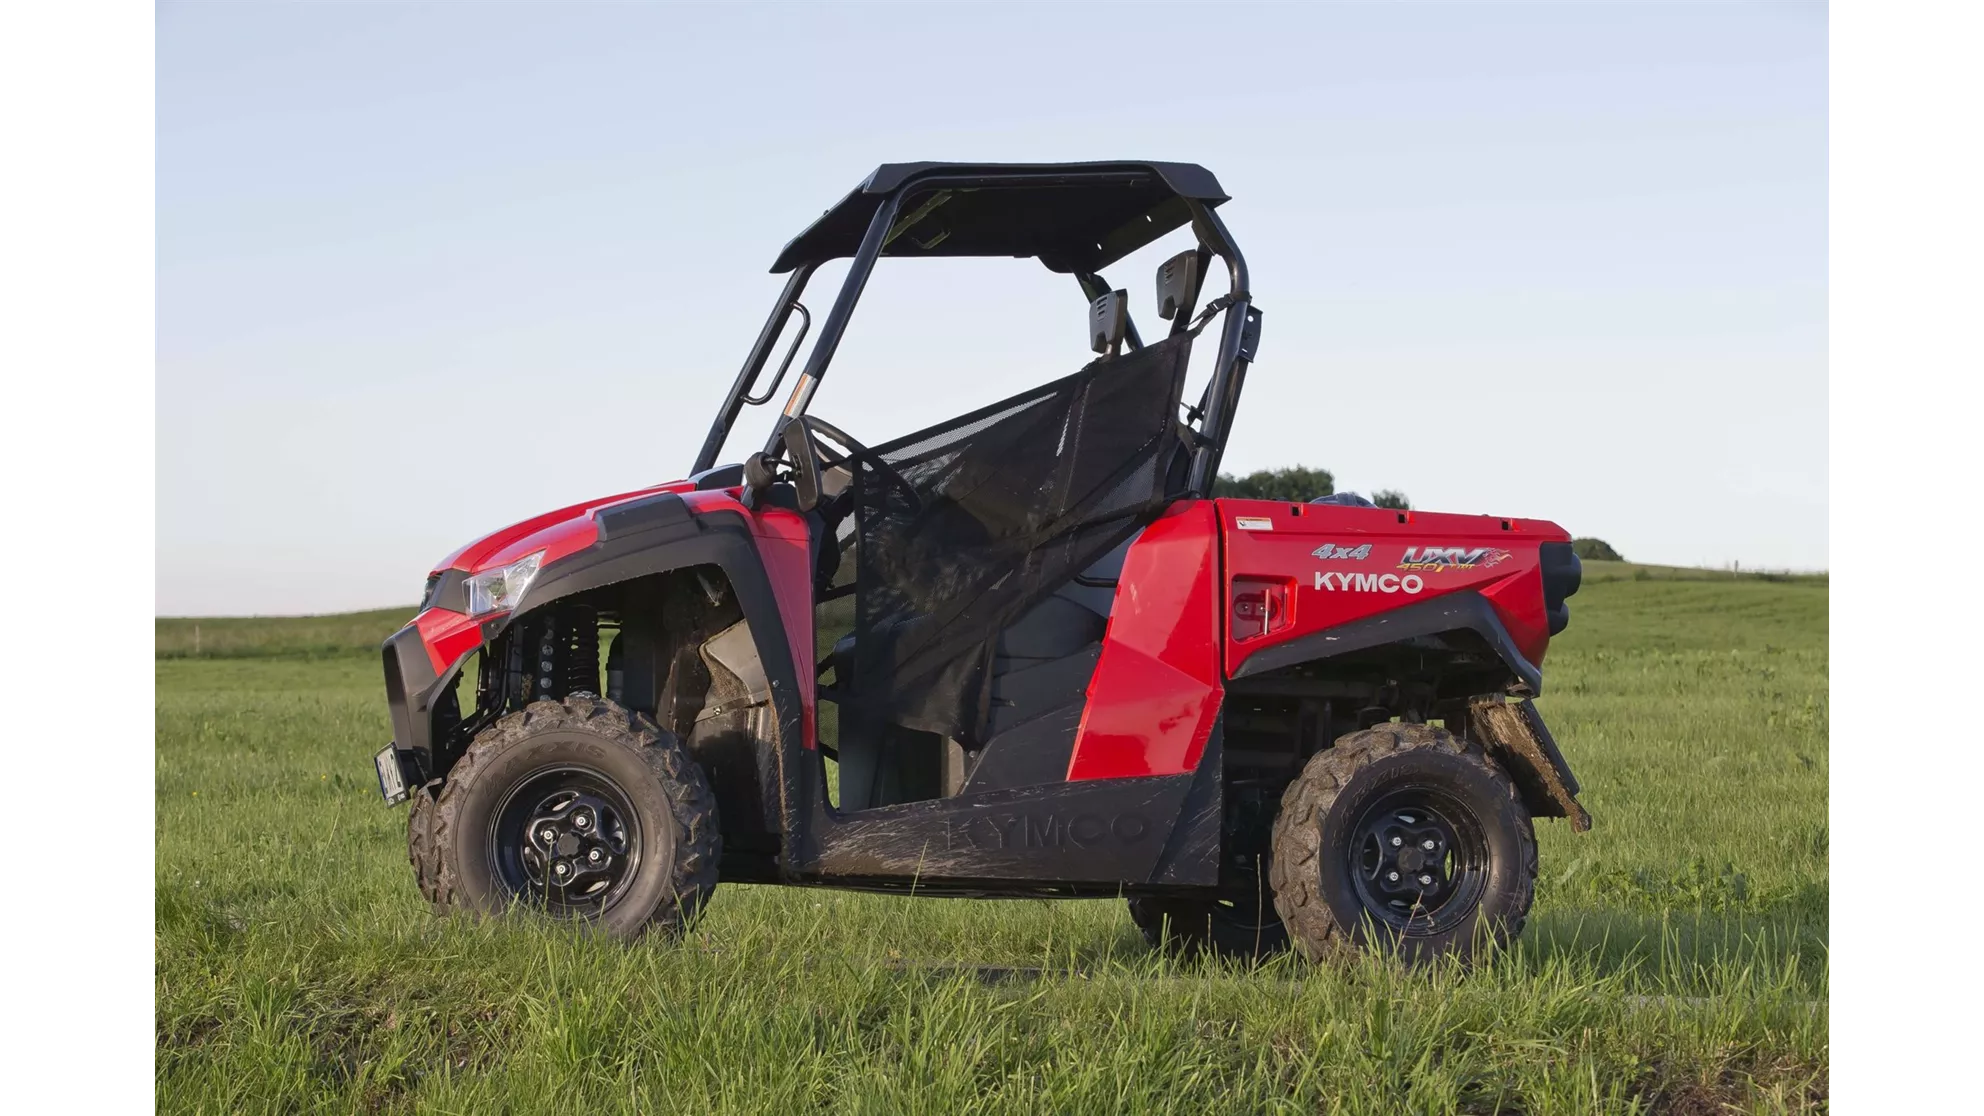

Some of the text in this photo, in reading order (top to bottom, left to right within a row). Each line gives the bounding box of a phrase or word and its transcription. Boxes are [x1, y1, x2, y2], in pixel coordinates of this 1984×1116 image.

[1311, 543, 1373, 560] 4x4
[1401, 546, 1485, 566] UXV
[1314, 571, 1424, 594] KYMCO
[946, 812, 1149, 851] KYMCO
